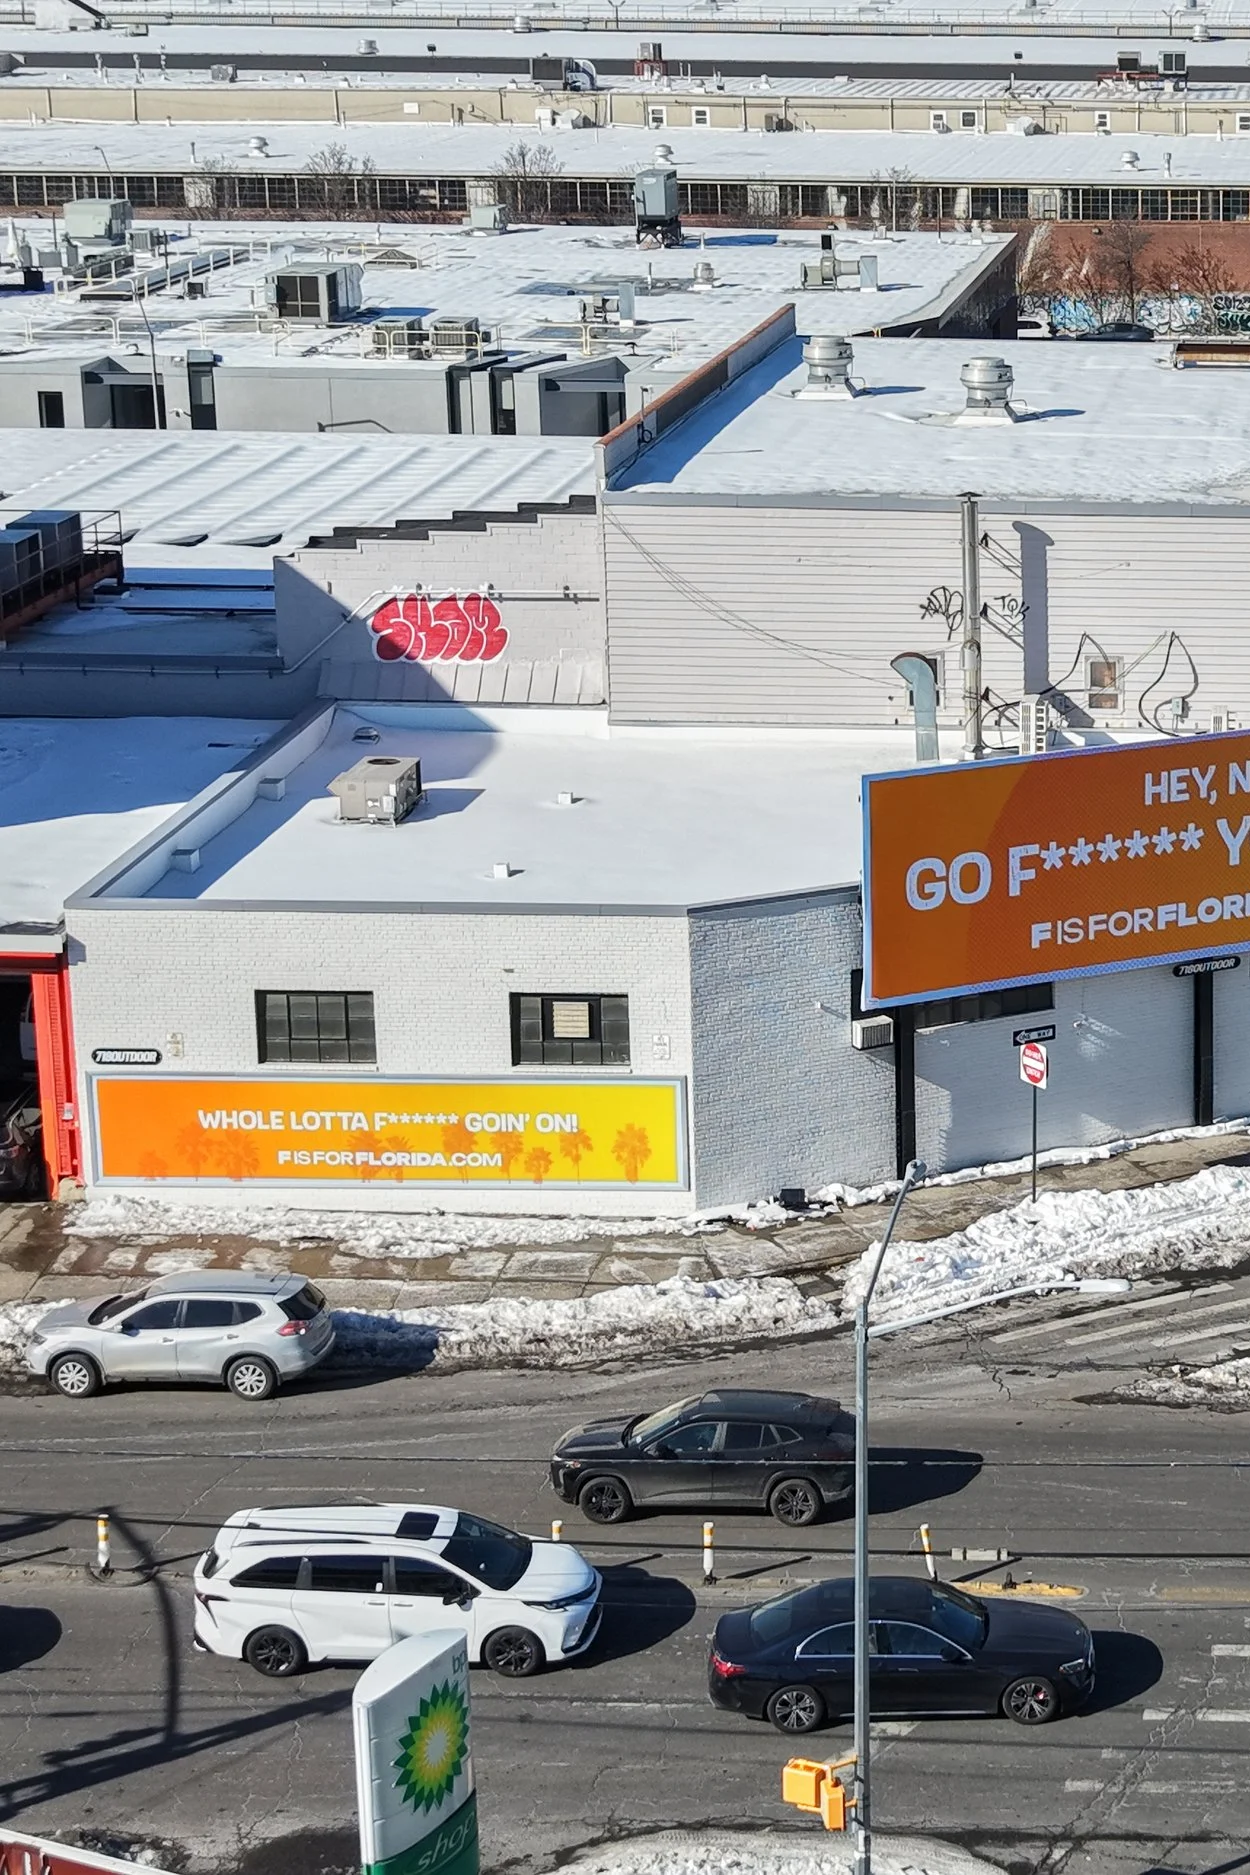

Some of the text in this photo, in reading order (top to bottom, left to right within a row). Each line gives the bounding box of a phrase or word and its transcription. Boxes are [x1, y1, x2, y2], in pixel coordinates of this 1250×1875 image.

[1144, 764, 1217, 806] HEY,
[905, 851, 992, 911] GO
[1179, 958, 1235, 975] 718OUTDOOR
[95, 1051, 157, 1063] 718OUTDOOR
[197, 1109, 285, 1131] WHOLE
[290, 1111, 369, 1131] LOTTA
[464, 1112, 530, 1133] GOIN'
[535, 1113, 579, 1133] ON!
[452, 1650, 468, 1674] bp
[418, 1811, 475, 1873] shop
